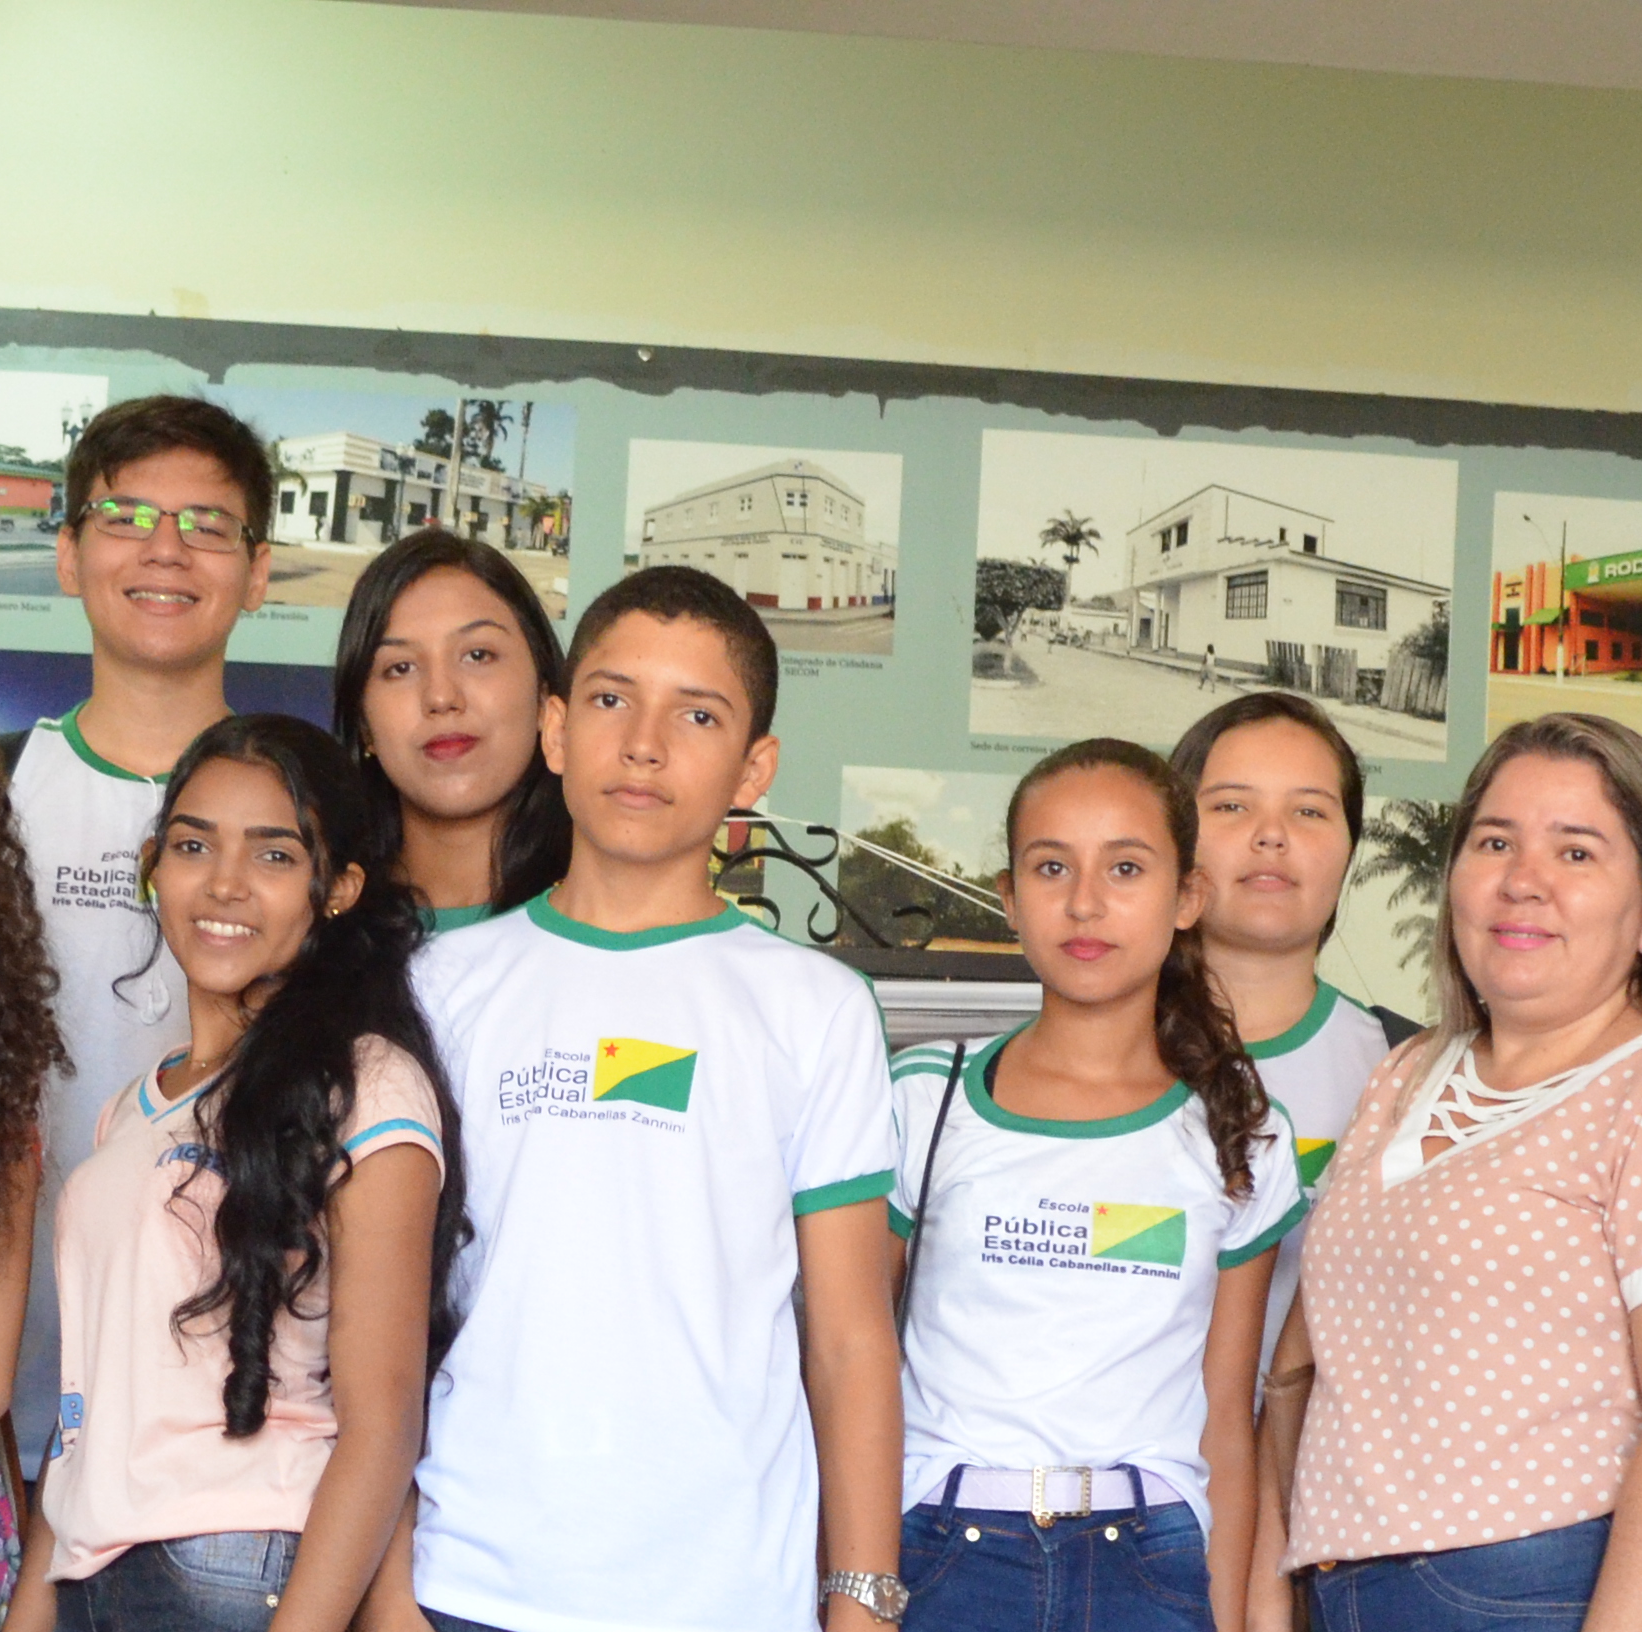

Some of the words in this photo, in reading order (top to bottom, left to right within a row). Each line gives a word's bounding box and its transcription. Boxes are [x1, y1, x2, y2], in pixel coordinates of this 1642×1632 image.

[784, 666, 820, 677] SECOM
[57, 866, 137, 884] Pública
[55, 882, 136, 900] Estadual
[544, 1048, 591, 1062] Escola
[548, 1104, 627, 1120] Cabanellas
[631, 1110, 686, 1134] Zannini
[1038, 1198, 1090, 1214] Escola
[984, 1215, 1088, 1239] Pública
[984, 1236, 1087, 1256] Estadual
[981, 1253, 1003, 1264] Iris
[1008, 1254, 1044, 1267] Célia
[1049, 1258, 1127, 1274] Cabanellas
[1131, 1264, 1181, 1281] Zannini
